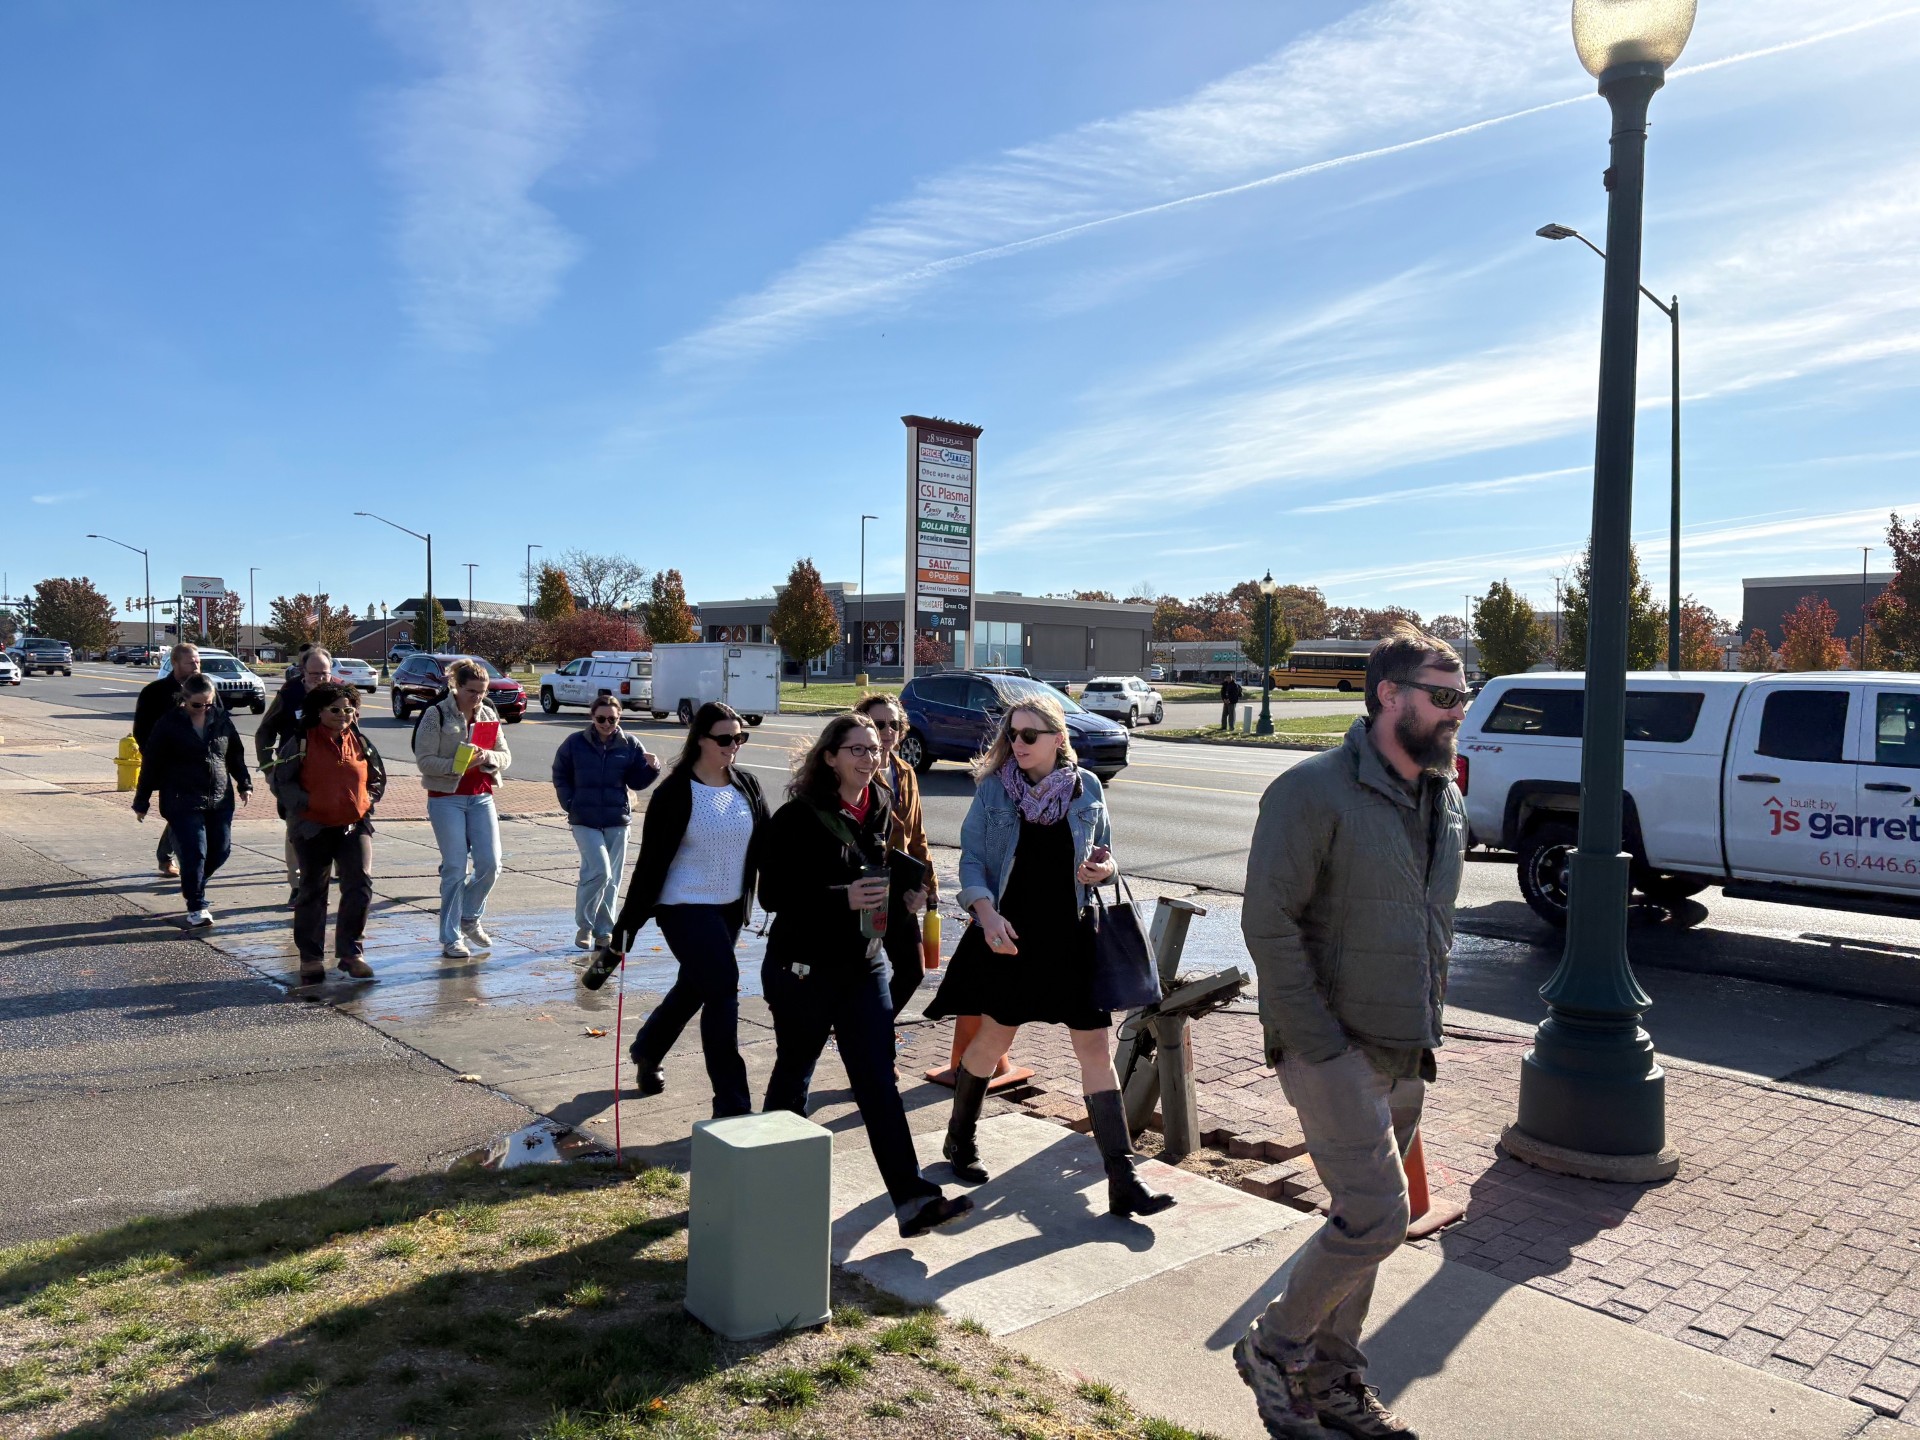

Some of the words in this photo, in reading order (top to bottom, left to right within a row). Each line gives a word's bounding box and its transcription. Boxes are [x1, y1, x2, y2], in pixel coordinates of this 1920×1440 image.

[926, 433, 935, 443] 28
[921, 448, 940, 458] PRICE
[921, 468, 937, 477] Once
[921, 485, 936, 498] CSL
[939, 487, 969, 502] Plasma
[921, 521, 949, 532] DOLLAR
[950, 525, 968, 534] TREE
[929, 559, 951, 569] SALLY
[935, 572, 959, 581] Payless
[940, 616, 957, 626] AT&T
[1790, 797, 1816, 809] built
[1820, 799, 1837, 812] by
[1769, 809, 1801, 836] js
[1819, 851, 1920, 874] 616.446.6
